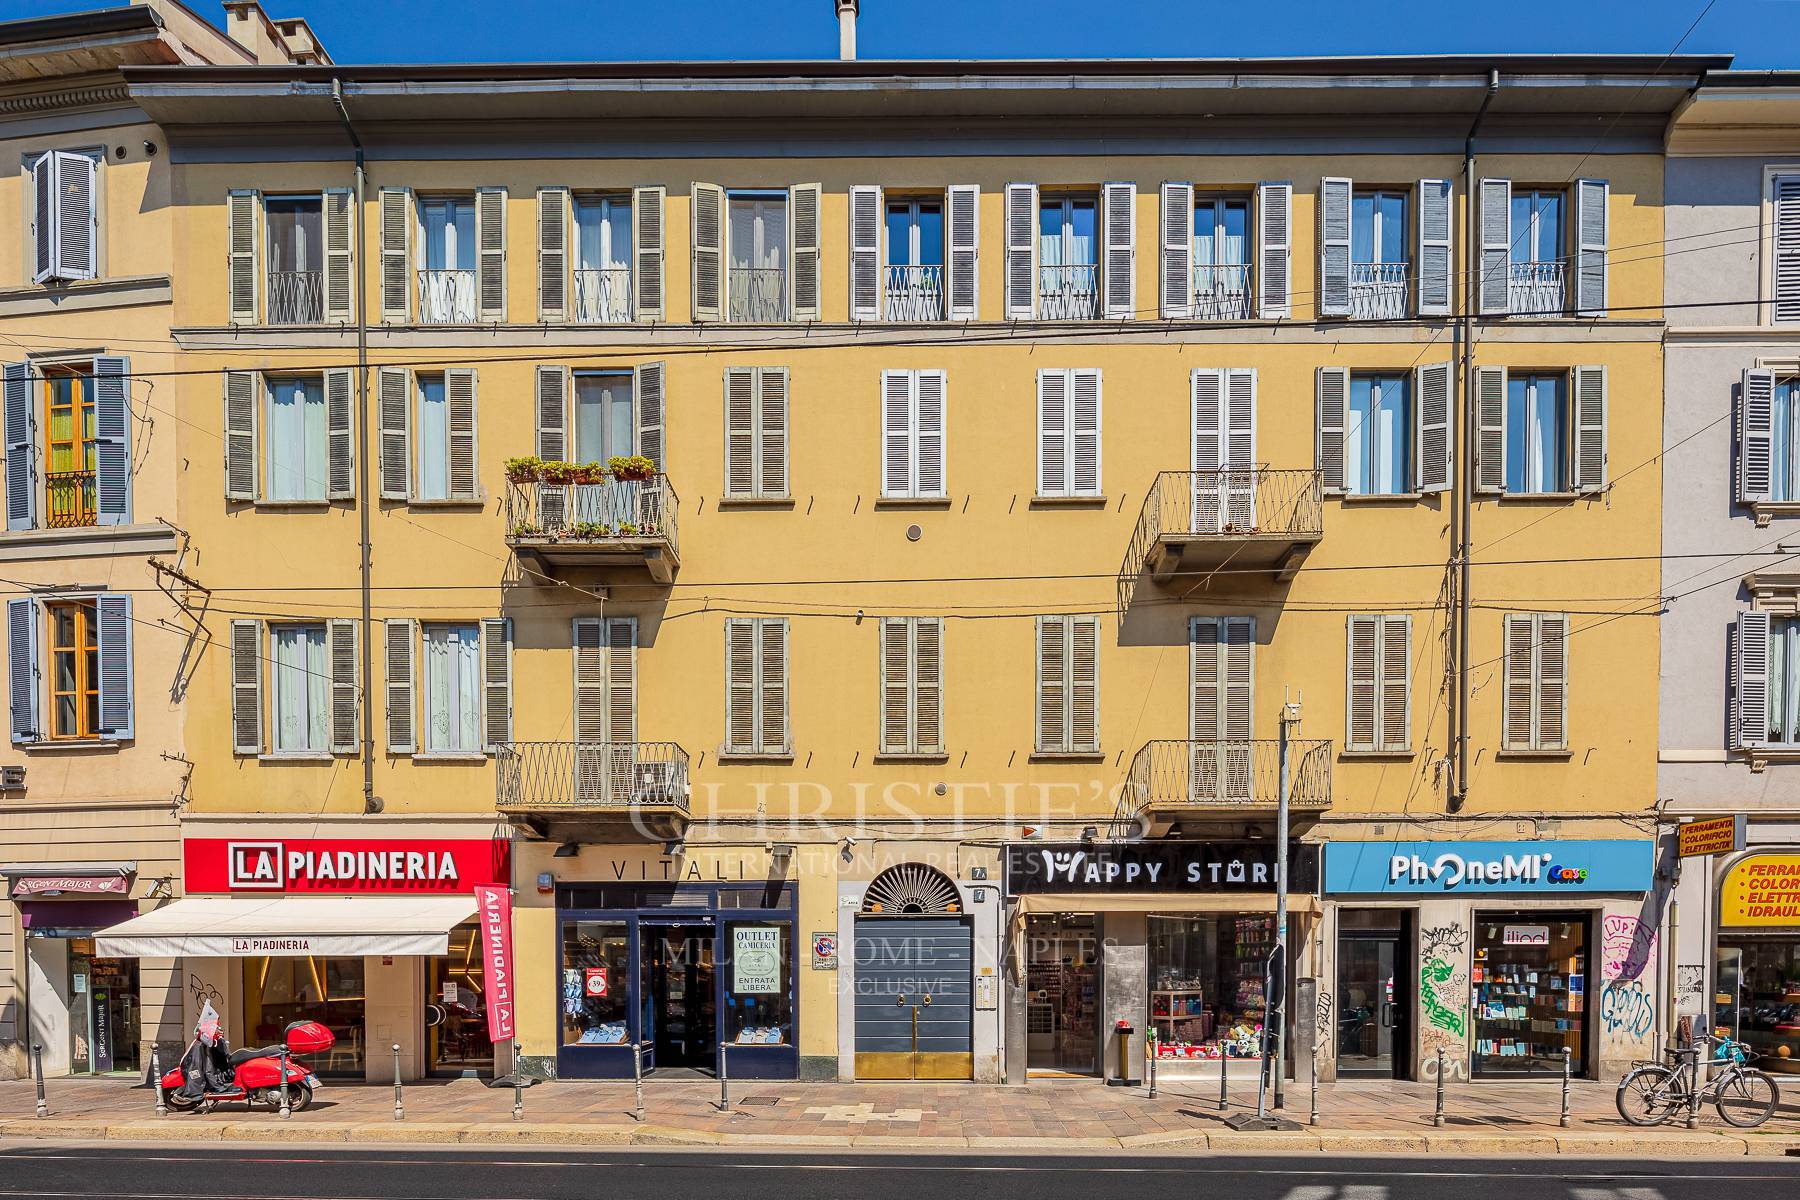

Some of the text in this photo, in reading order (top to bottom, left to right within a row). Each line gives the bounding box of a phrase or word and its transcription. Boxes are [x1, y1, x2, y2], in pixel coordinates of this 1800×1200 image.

[1685, 820, 1733, 834] FERRAMENTA
[1685, 830, 1732, 844] COLORIFICIO
[237, 850, 458, 880] LA PIADINERIA
[612, 860, 745, 880] VITALI
[1187, 859, 1278, 883] STOR
[1550, 864, 1589, 880] Case
[976, 890, 983, 900] 7
[736, 931, 778, 941] OUTLET
[235, 941, 310, 951] LA PIADINERIA
